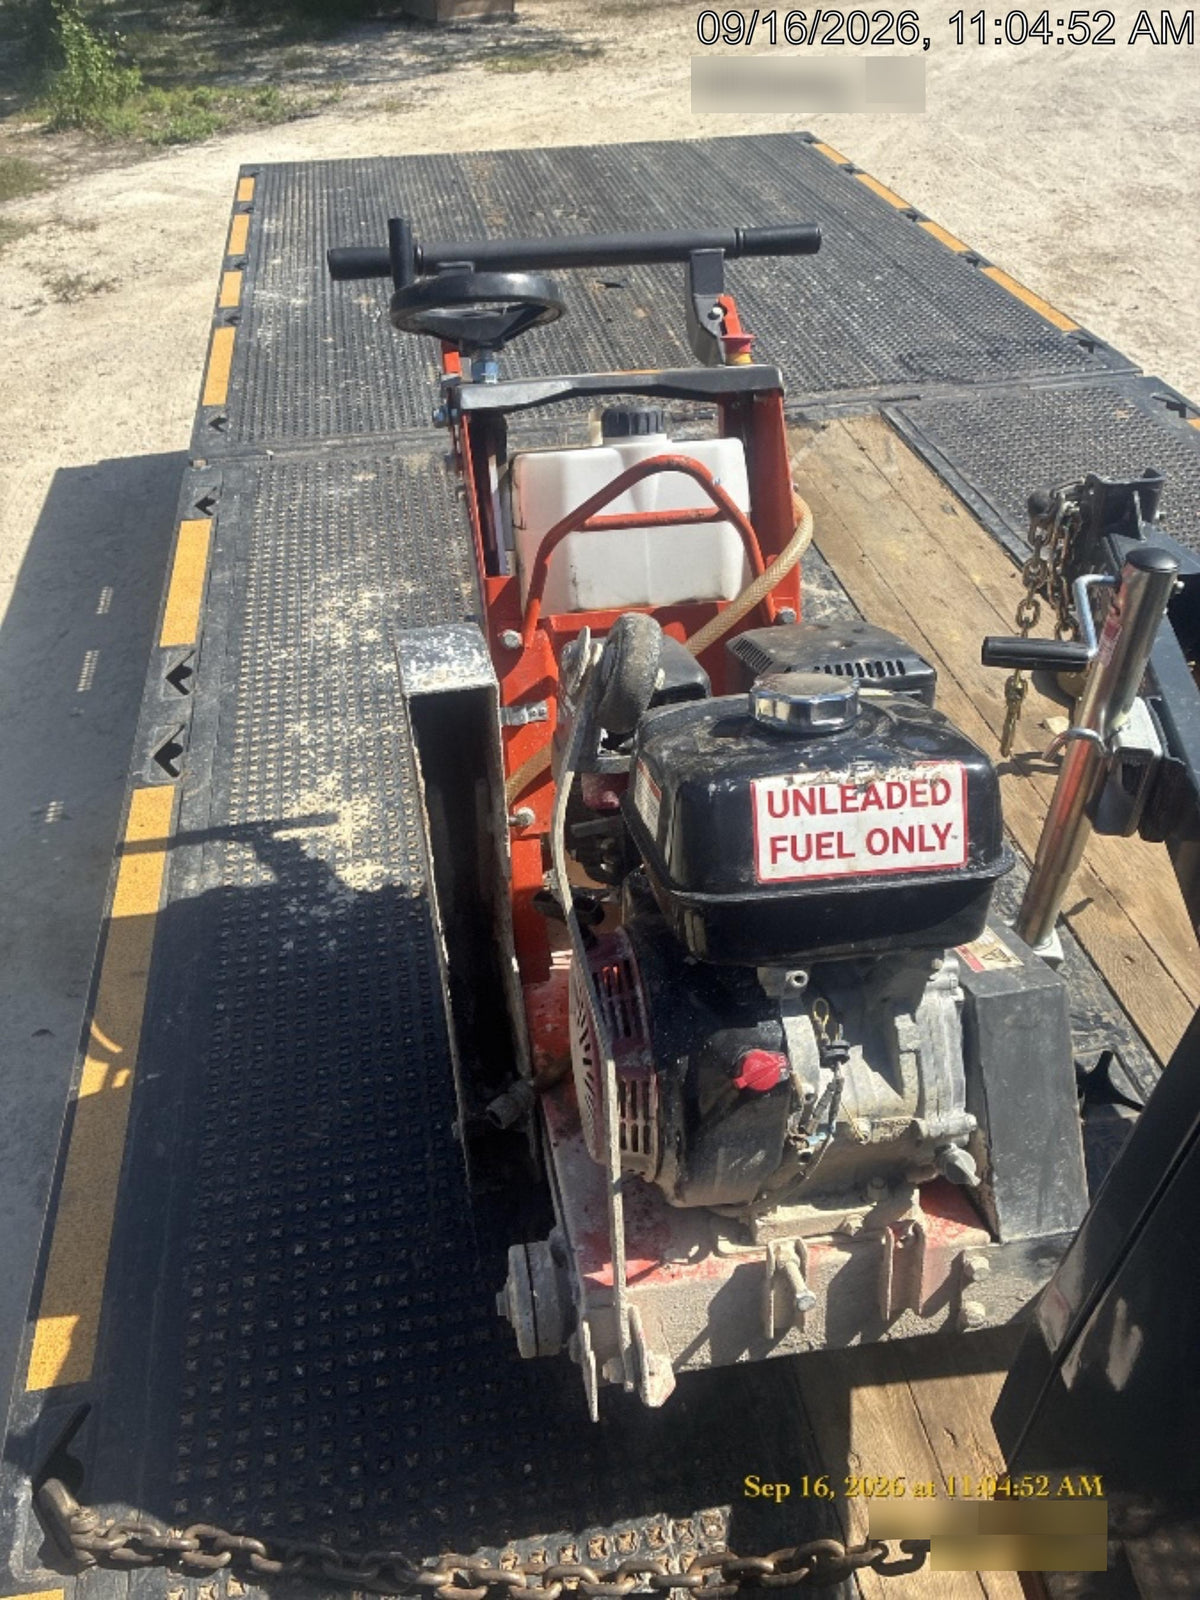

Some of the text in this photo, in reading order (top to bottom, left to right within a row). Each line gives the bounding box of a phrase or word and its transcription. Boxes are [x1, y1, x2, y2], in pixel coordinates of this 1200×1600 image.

[767, 778, 952, 819] UNLEADED
[769, 822, 953, 865] FUEL ONLY
